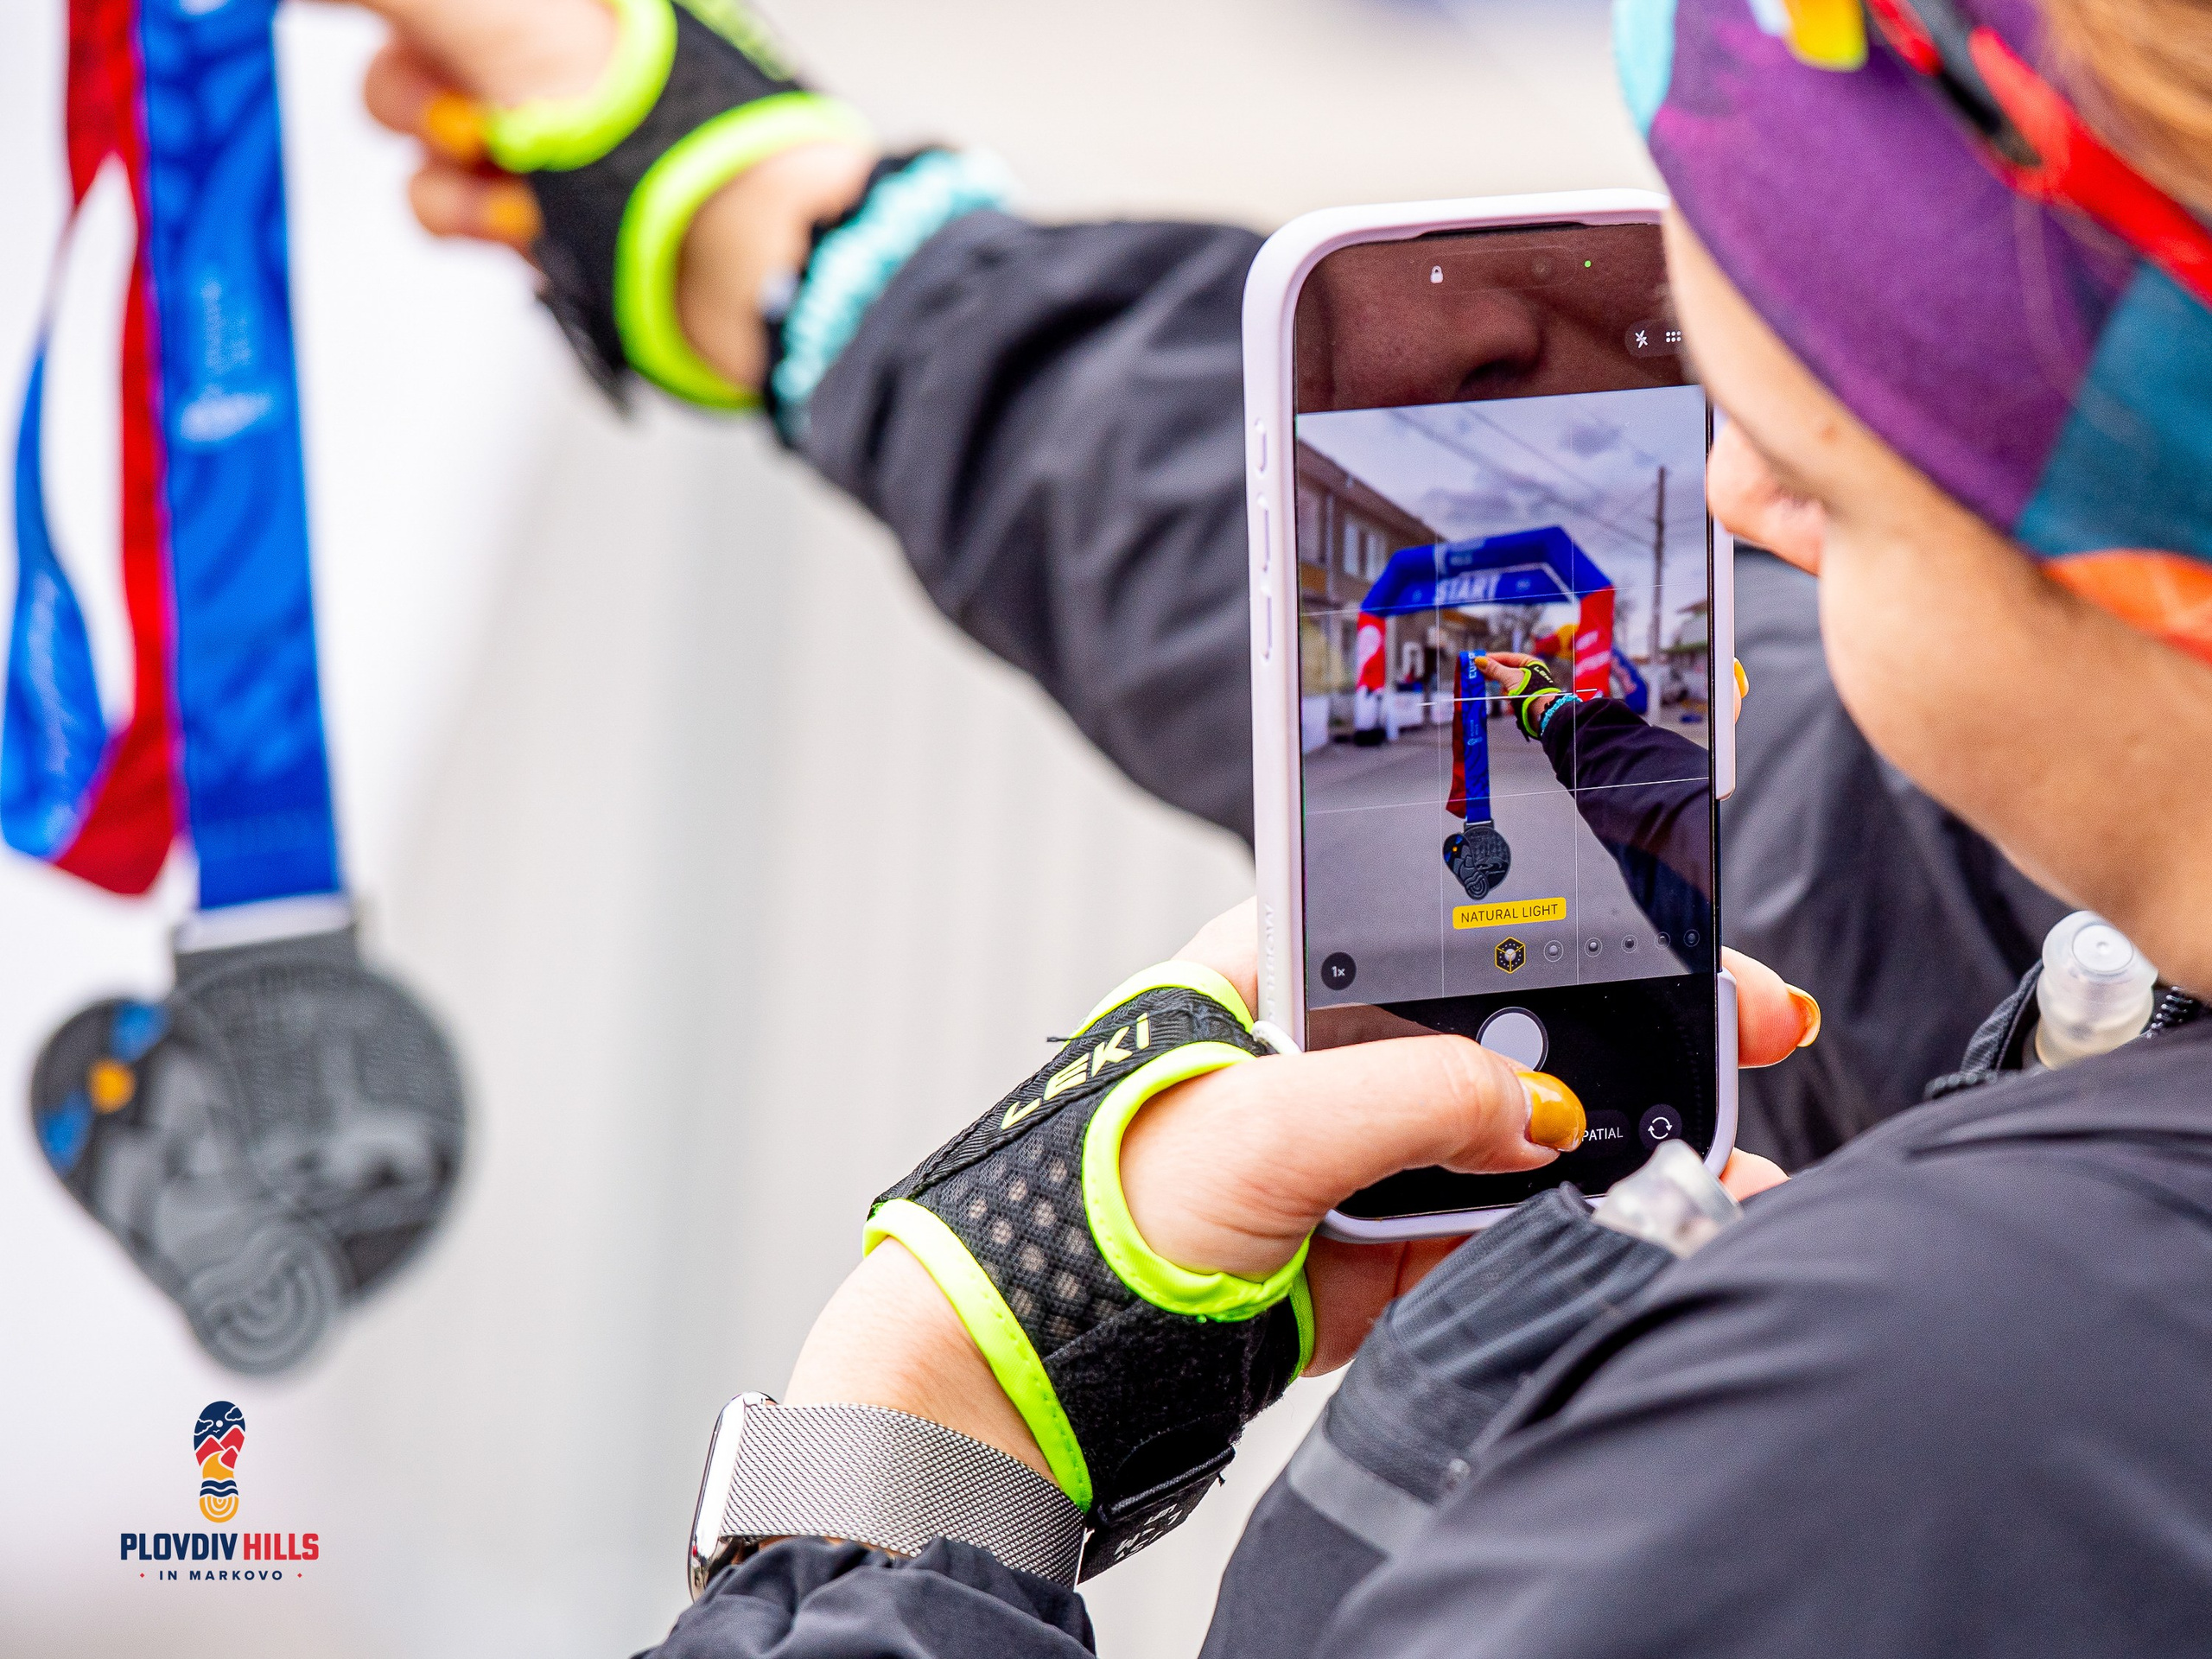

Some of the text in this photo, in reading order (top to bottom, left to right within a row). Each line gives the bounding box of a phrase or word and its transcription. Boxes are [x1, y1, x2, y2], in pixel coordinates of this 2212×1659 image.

[1461, 904, 1558, 923] NATURAL LIGHT
[1332, 965, 1345, 977] 1x
[1001, 1012, 1150, 1130] LEKI
[1581, 1127, 1624, 1141] PATIAL
